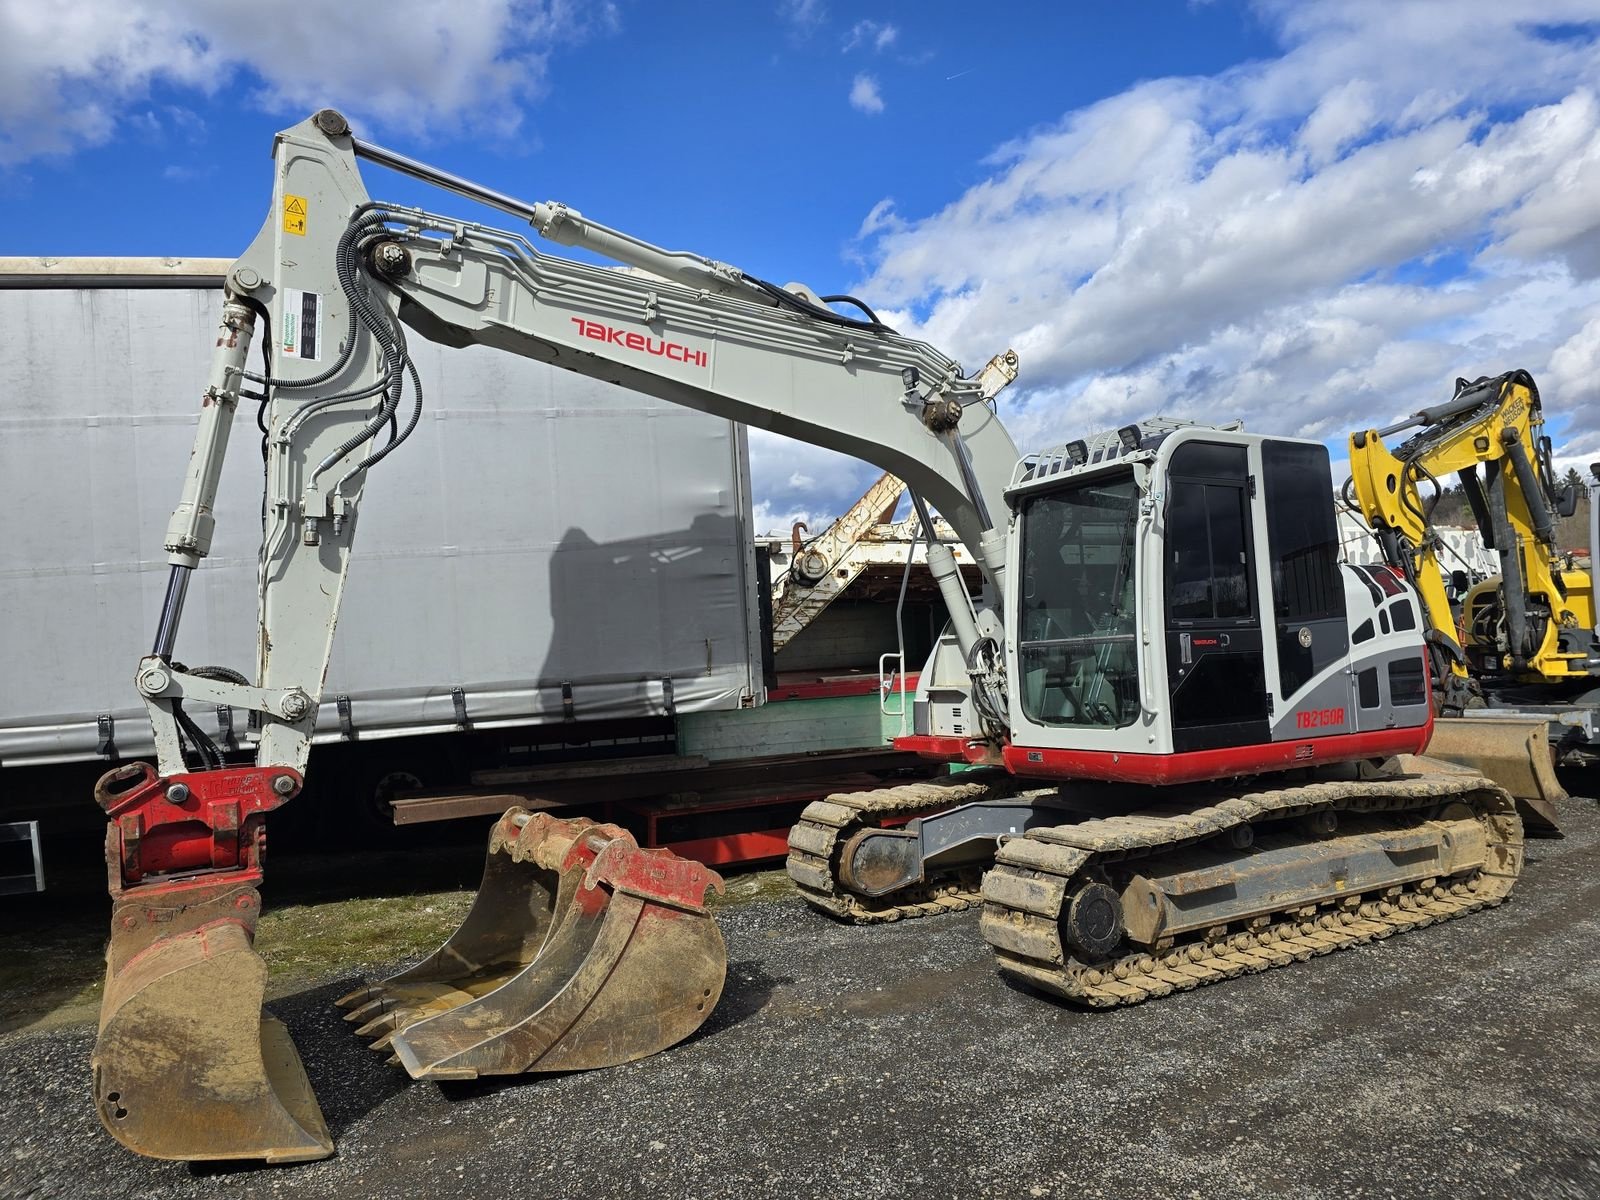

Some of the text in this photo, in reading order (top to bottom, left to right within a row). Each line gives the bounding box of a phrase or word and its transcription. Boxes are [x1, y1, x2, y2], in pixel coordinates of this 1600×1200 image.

[1501, 397, 1524, 419] WACKER
[1503, 405, 1525, 427] NEUSON
[1296, 707, 1345, 729] TB2150R
